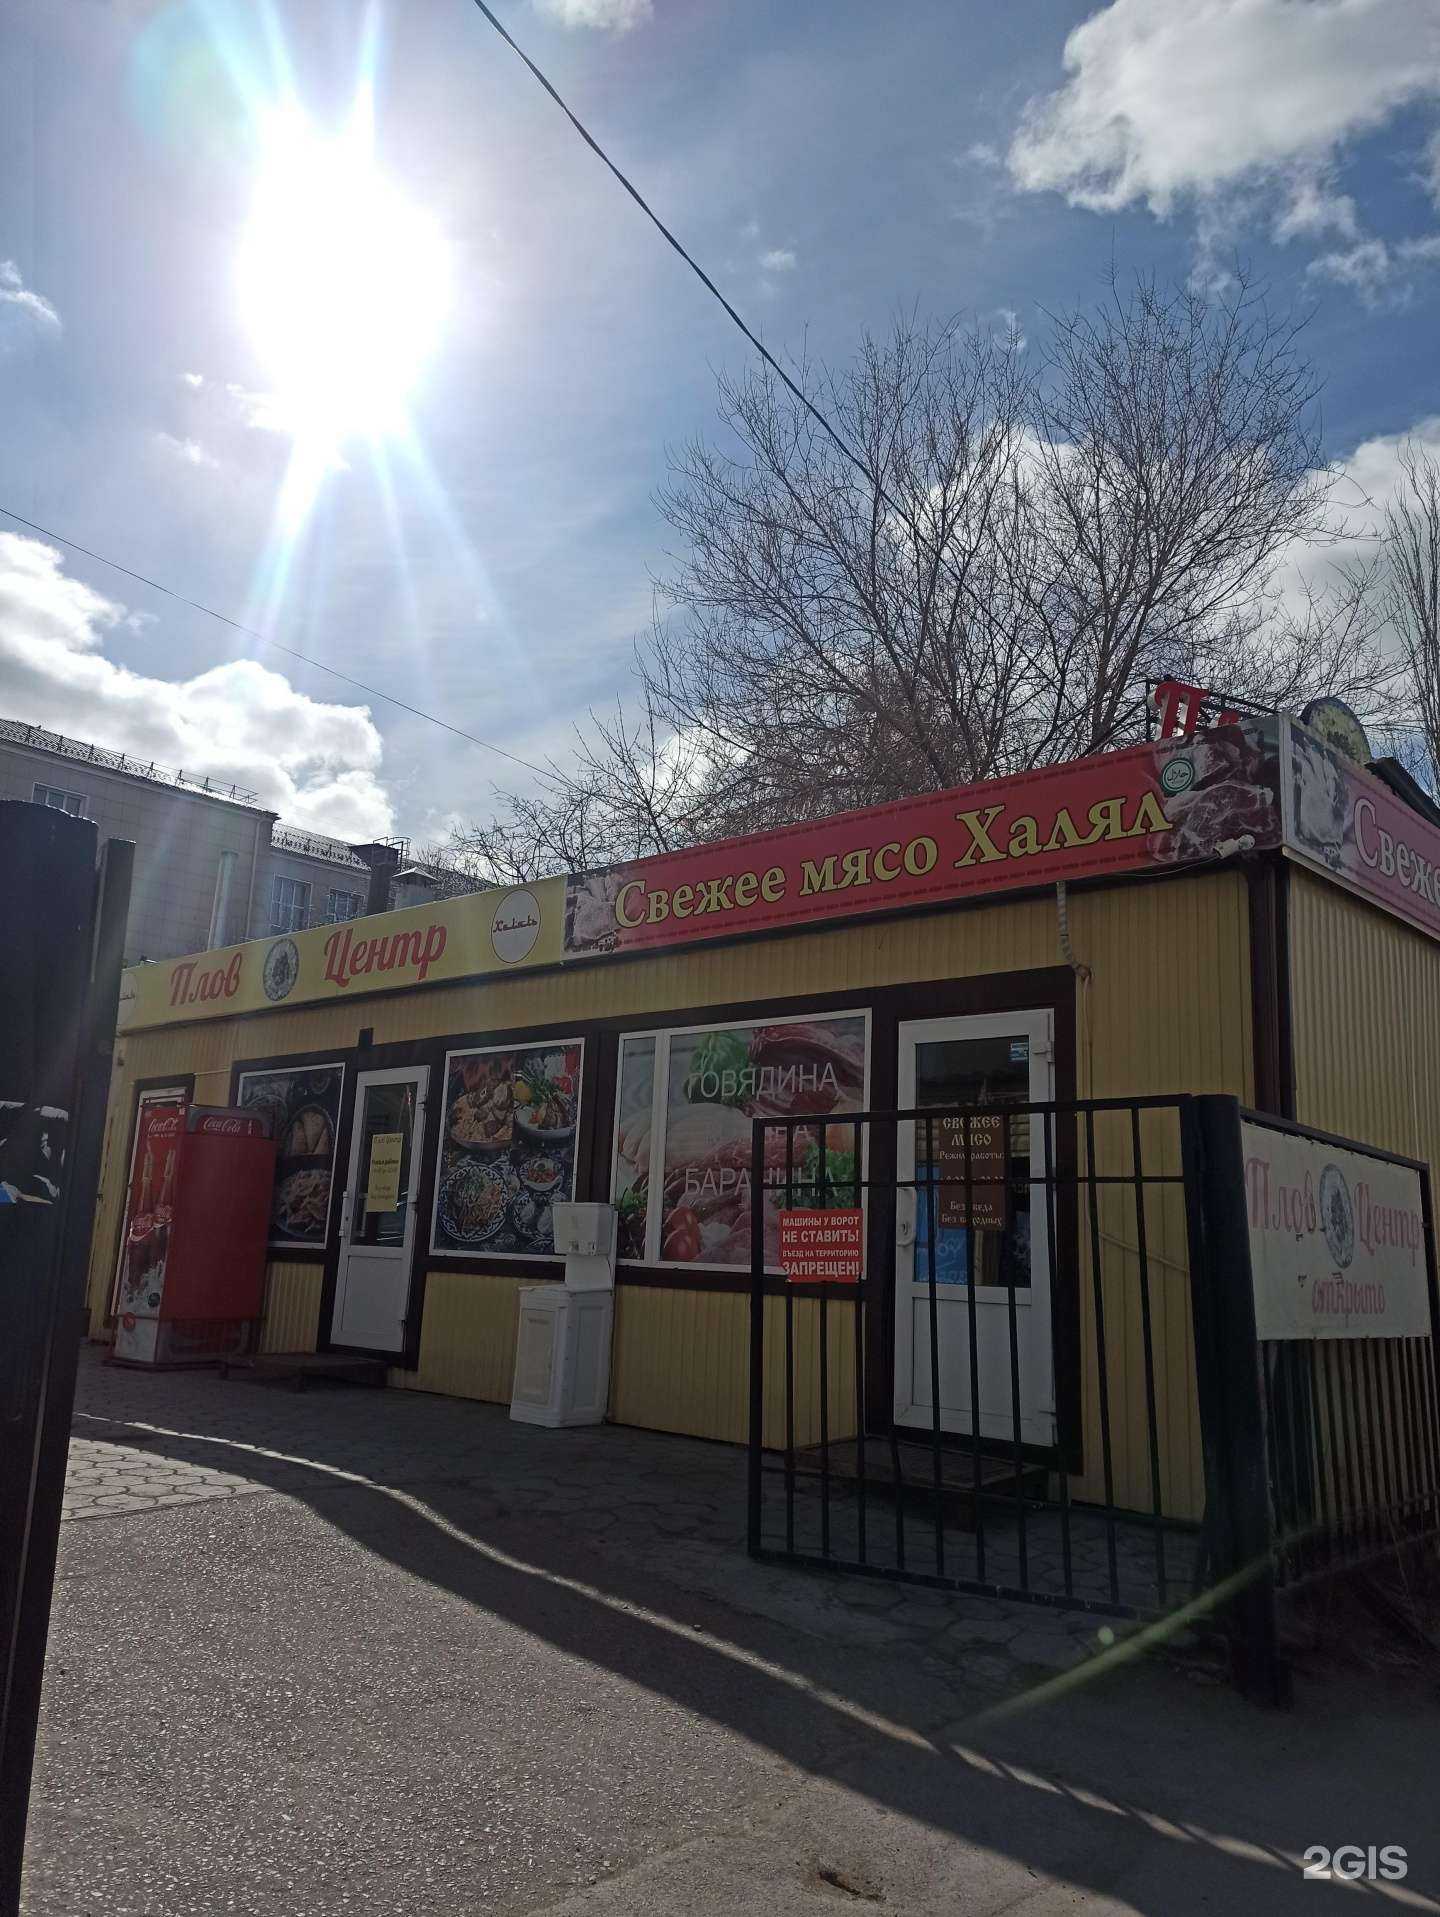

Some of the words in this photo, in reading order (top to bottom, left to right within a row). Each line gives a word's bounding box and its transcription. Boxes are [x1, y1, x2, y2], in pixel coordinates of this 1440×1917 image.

[613, 862, 787, 929] Свежее
[798, 833, 938, 898] мясо
[954, 790, 1173, 870] Халял
[169, 952, 242, 1006] Плов
[323, 921, 448, 988] Центр
[687, 1062, 839, 1100] ГОВЯДИНА
[783, 1217, 822, 1227] МАШИНЫ
[823, 1216, 829, 1226] У
[831, 1216, 860, 1226] ВОРОТ
[1244, 1157, 1317, 1234] Плов
[1353, 1182, 1424, 1268] Центр
[783, 1230, 798, 1243] НЕ
[801, 1230, 859, 1243] СТАВИТЬ!
[783, 1250, 804, 1258] ВЪЕЗД
[816, 1249, 859, 1257] ТЕРРИТОРИЮ
[782, 1261, 860, 1278] ЗАПРЕЩЕН!
